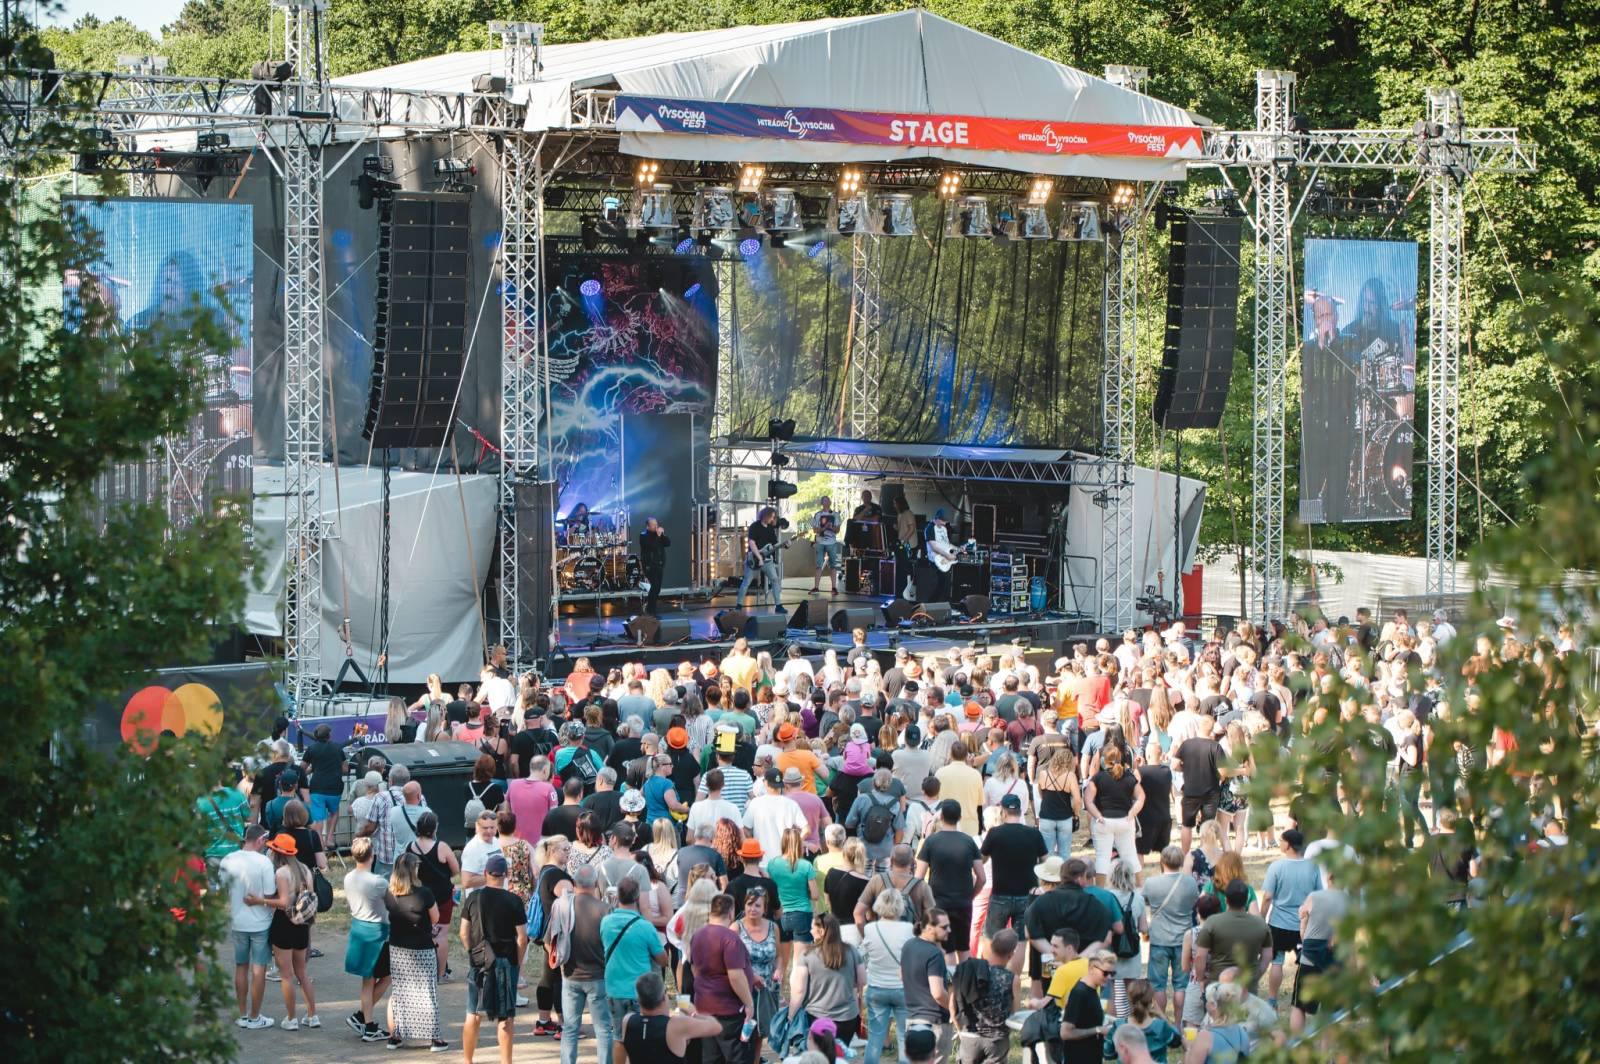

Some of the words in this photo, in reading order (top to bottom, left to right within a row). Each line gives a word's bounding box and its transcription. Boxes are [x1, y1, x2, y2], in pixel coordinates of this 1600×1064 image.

[682, 118, 706, 129] FEST
[889, 119, 969, 144] STAGE
[1146, 142, 1165, 152] FEST
